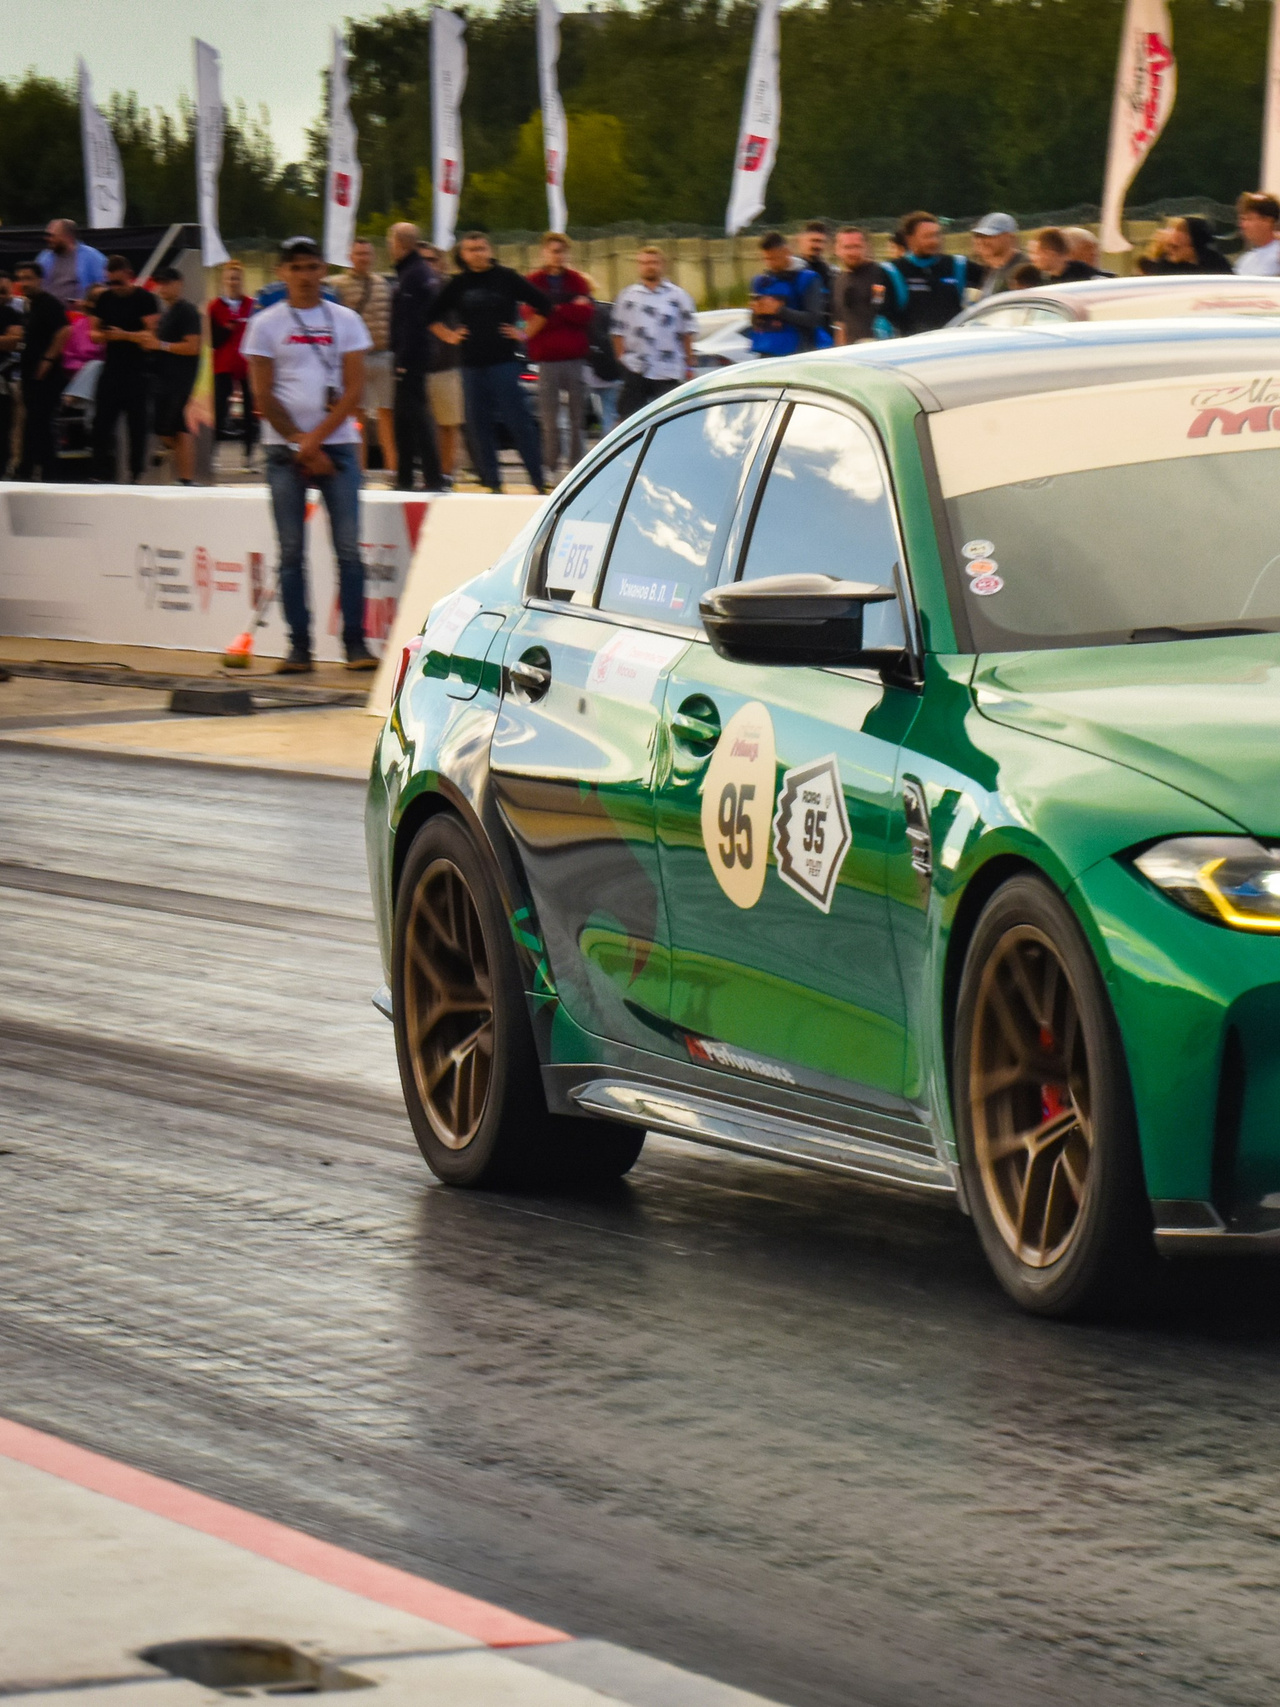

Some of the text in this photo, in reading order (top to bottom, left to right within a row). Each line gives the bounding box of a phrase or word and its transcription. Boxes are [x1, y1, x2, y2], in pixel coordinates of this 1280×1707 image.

[563, 543, 594, 580] ВТБ
[718, 782, 756, 870] 95
[803, 808, 828, 855] 95
